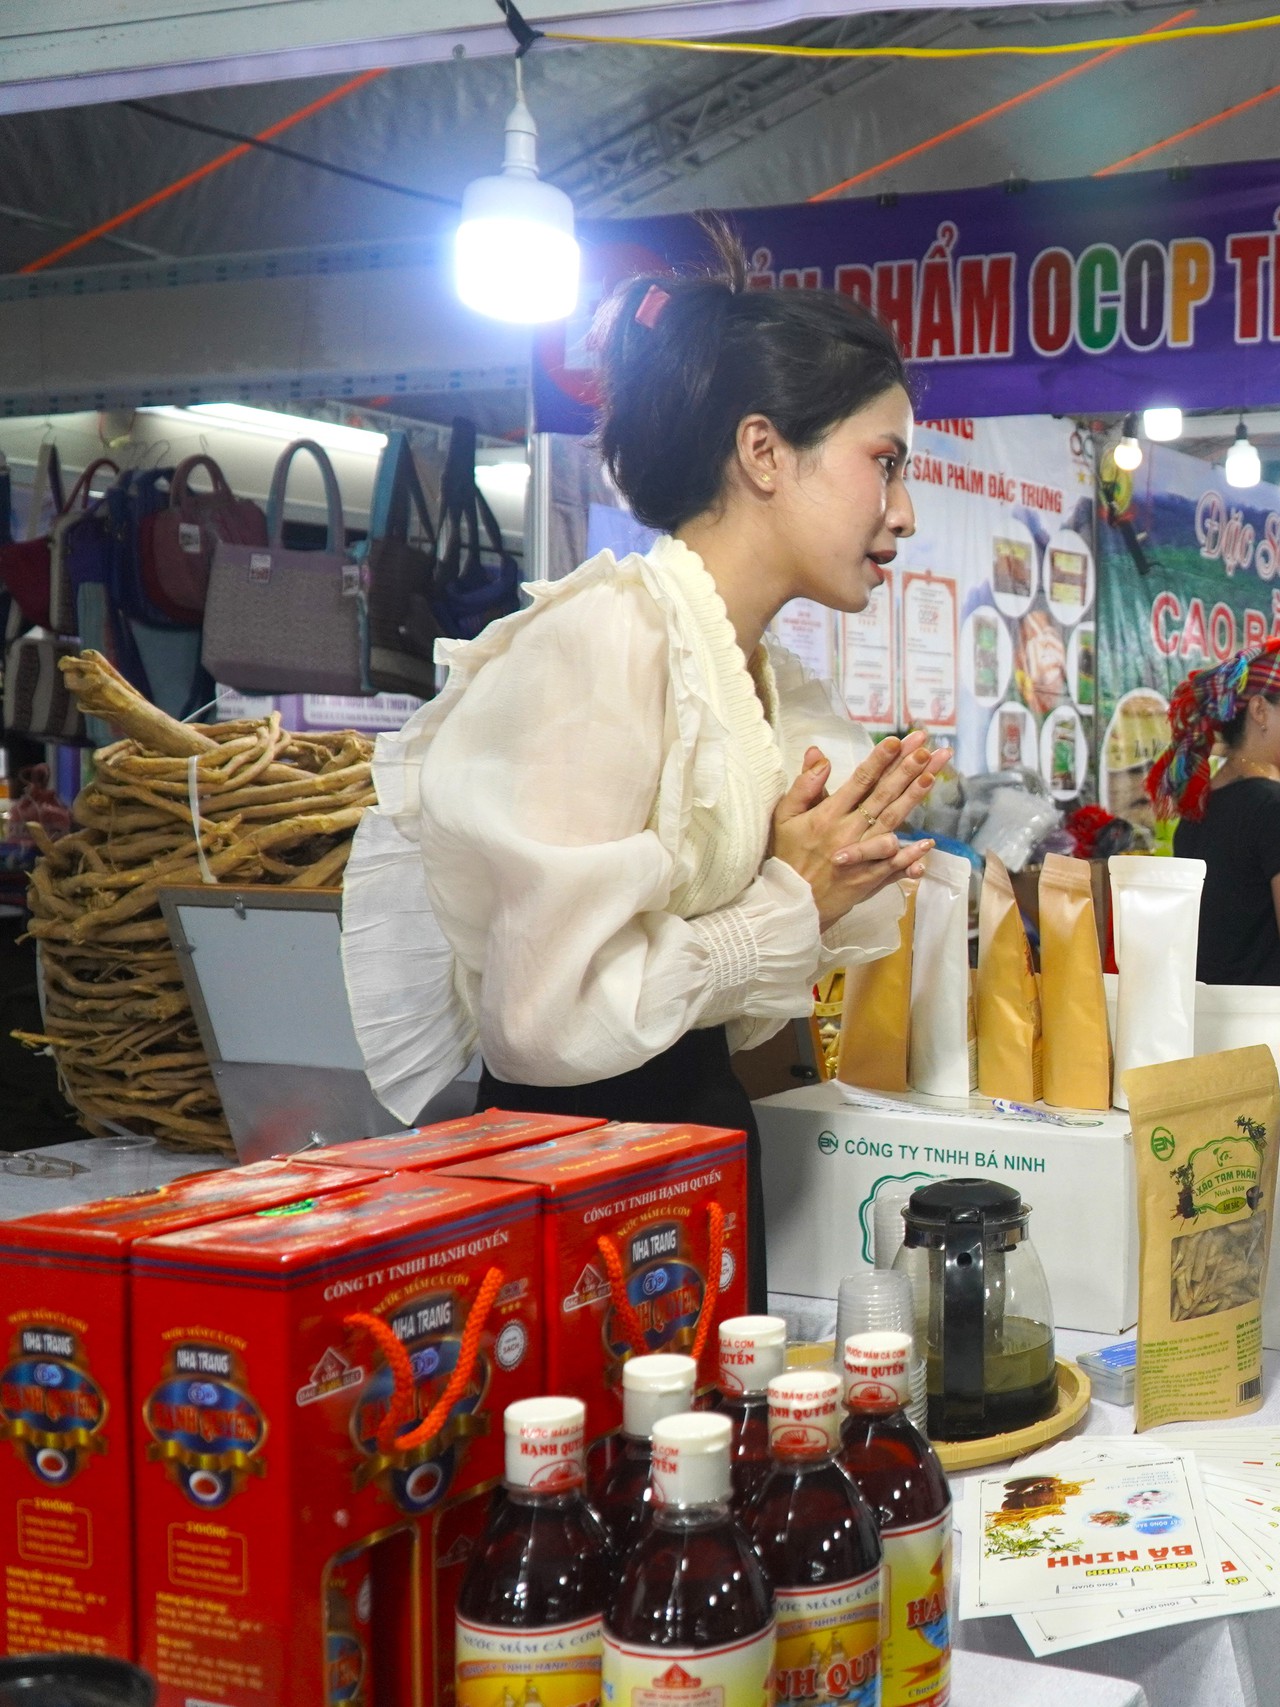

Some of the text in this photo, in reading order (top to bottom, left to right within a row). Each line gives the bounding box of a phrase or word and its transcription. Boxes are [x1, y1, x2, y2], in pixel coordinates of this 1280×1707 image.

[1028, 239, 1215, 357] OCOP
[913, 448, 944, 486] SẢN
[1151, 590, 1236, 663] CAO
[845, 1137, 1046, 1173] CÔNG TY TNHH BÁ NINH
[1214, 1171, 1234, 1184] TAM
[1236, 1168, 1257, 1180] PHÂN
[583, 1208, 612, 1225] CÔNG
[613, 1202, 627, 1215] TY
[628, 1190, 657, 1209] TNHH
[658, 1181, 689, 1201] HẠNH
[1214, 1189, 1231, 1199] Ninh
[632, 1229, 677, 1262] NHA TRANG
[323, 1278, 364, 1303] CÔNG
[366, 1271, 384, 1289] TY
[387, 1256, 427, 1282] TNHH
[429, 1244, 467, 1270] HẠNH
[392, 1301, 452, 1340] NHA TRANG
[176, 1350, 230, 1374] NHA TRANG
[521, 1442, 557, 1458] HẠNH
[1047, 1544, 1193, 1569] BÁ NINH
[1085, 1560, 1198, 1578] CÔNG TY TNHH
